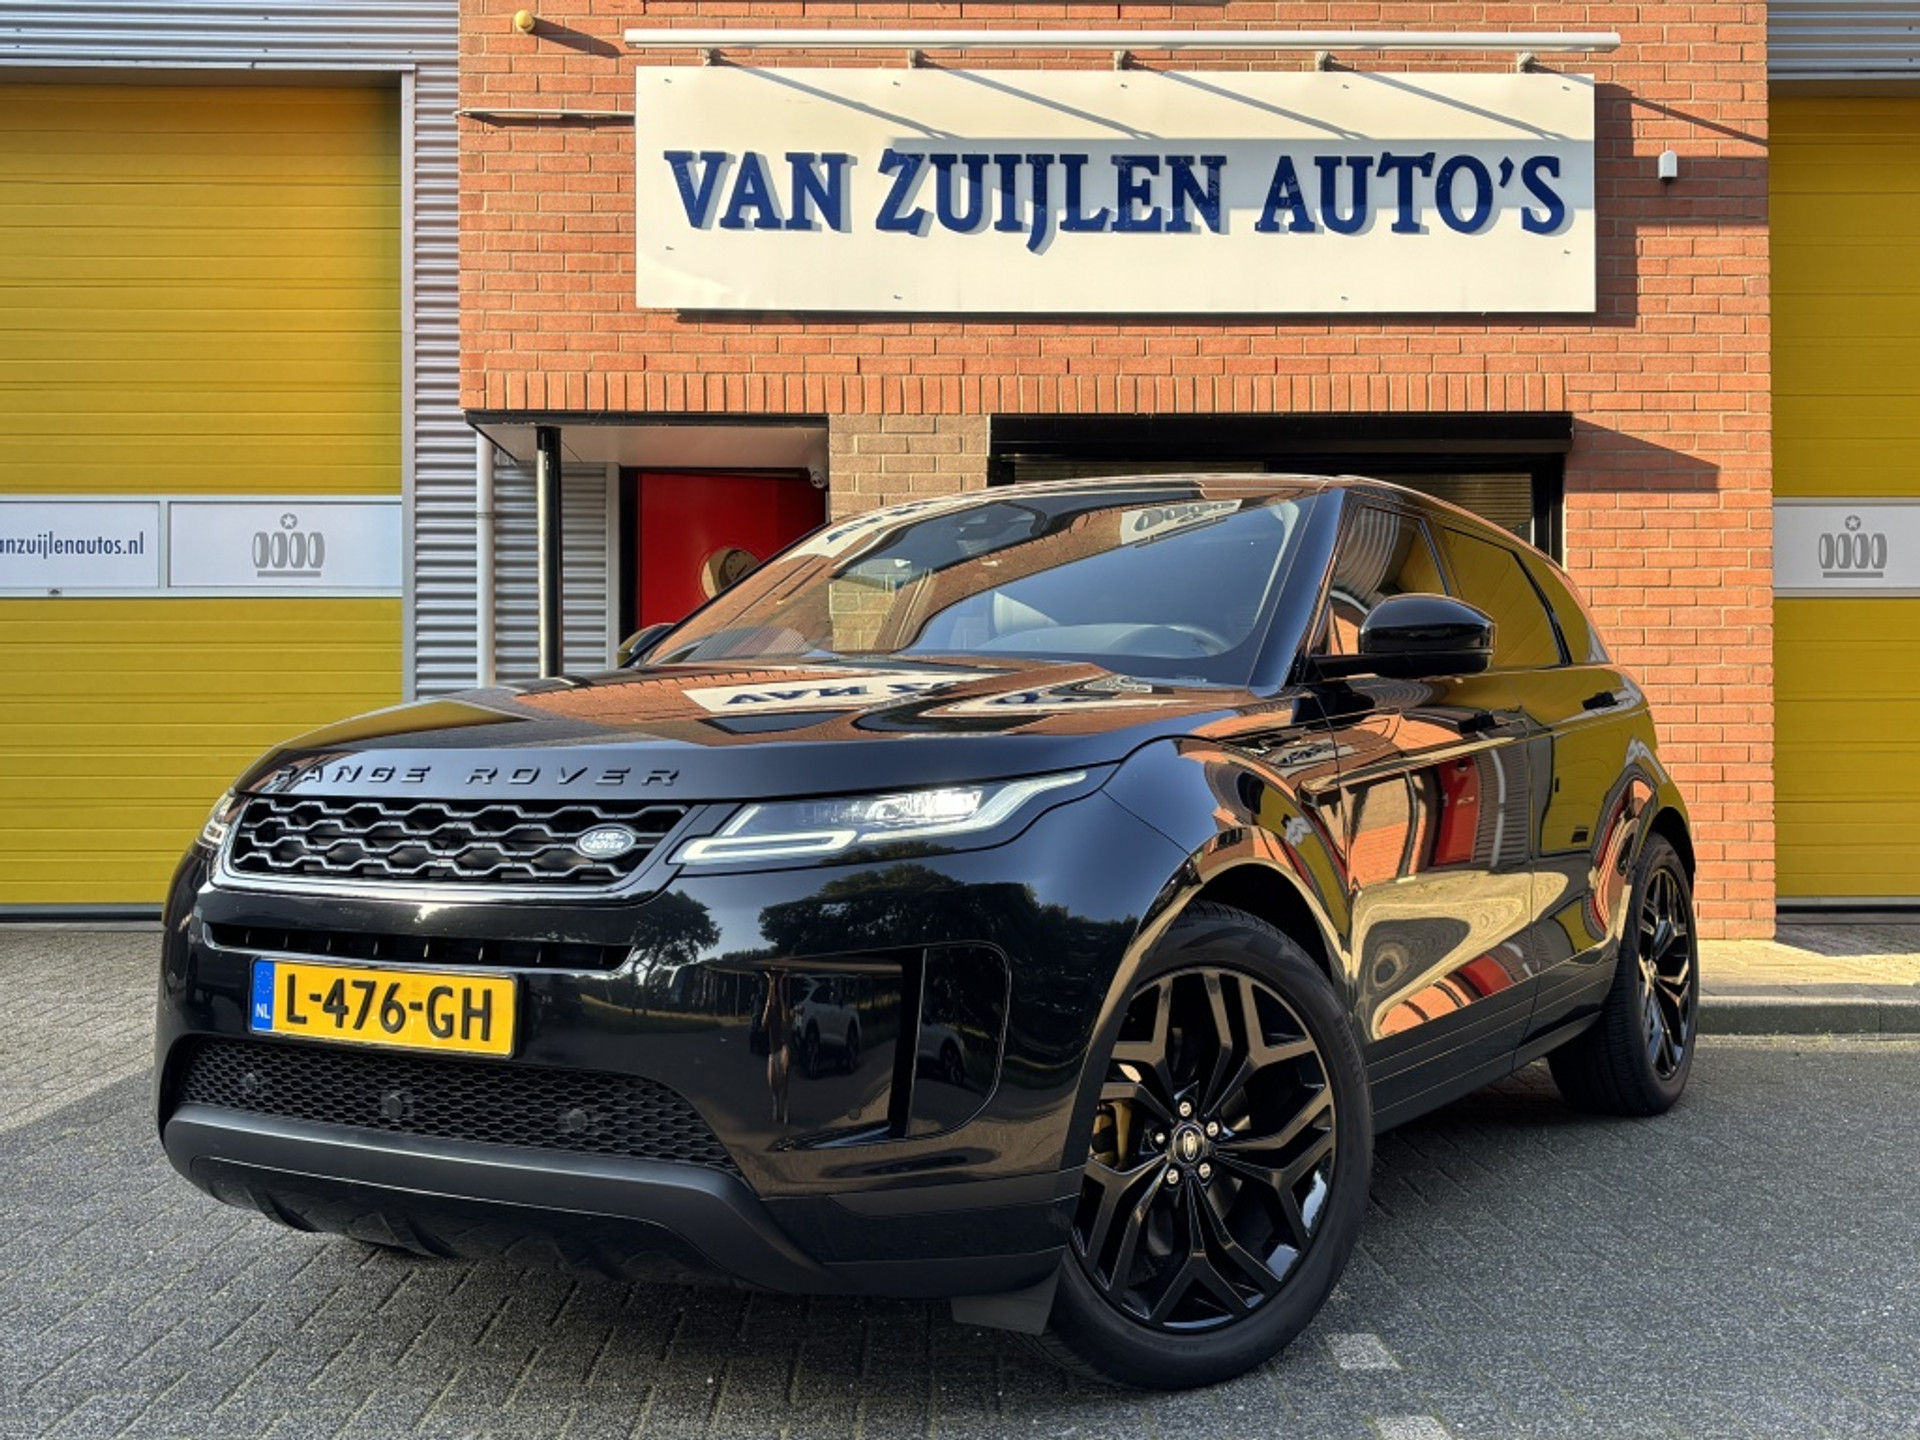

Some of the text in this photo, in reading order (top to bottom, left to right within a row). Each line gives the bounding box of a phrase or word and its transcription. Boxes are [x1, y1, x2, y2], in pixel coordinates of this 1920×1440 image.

[663, 148, 1571, 254] VAN ZUIJLEN AUTO'S
[275, 764, 680, 787] RANGE ROVER
[255, 1002, 271, 1019] NL
[286, 973, 493, 1042] L-476-GH
